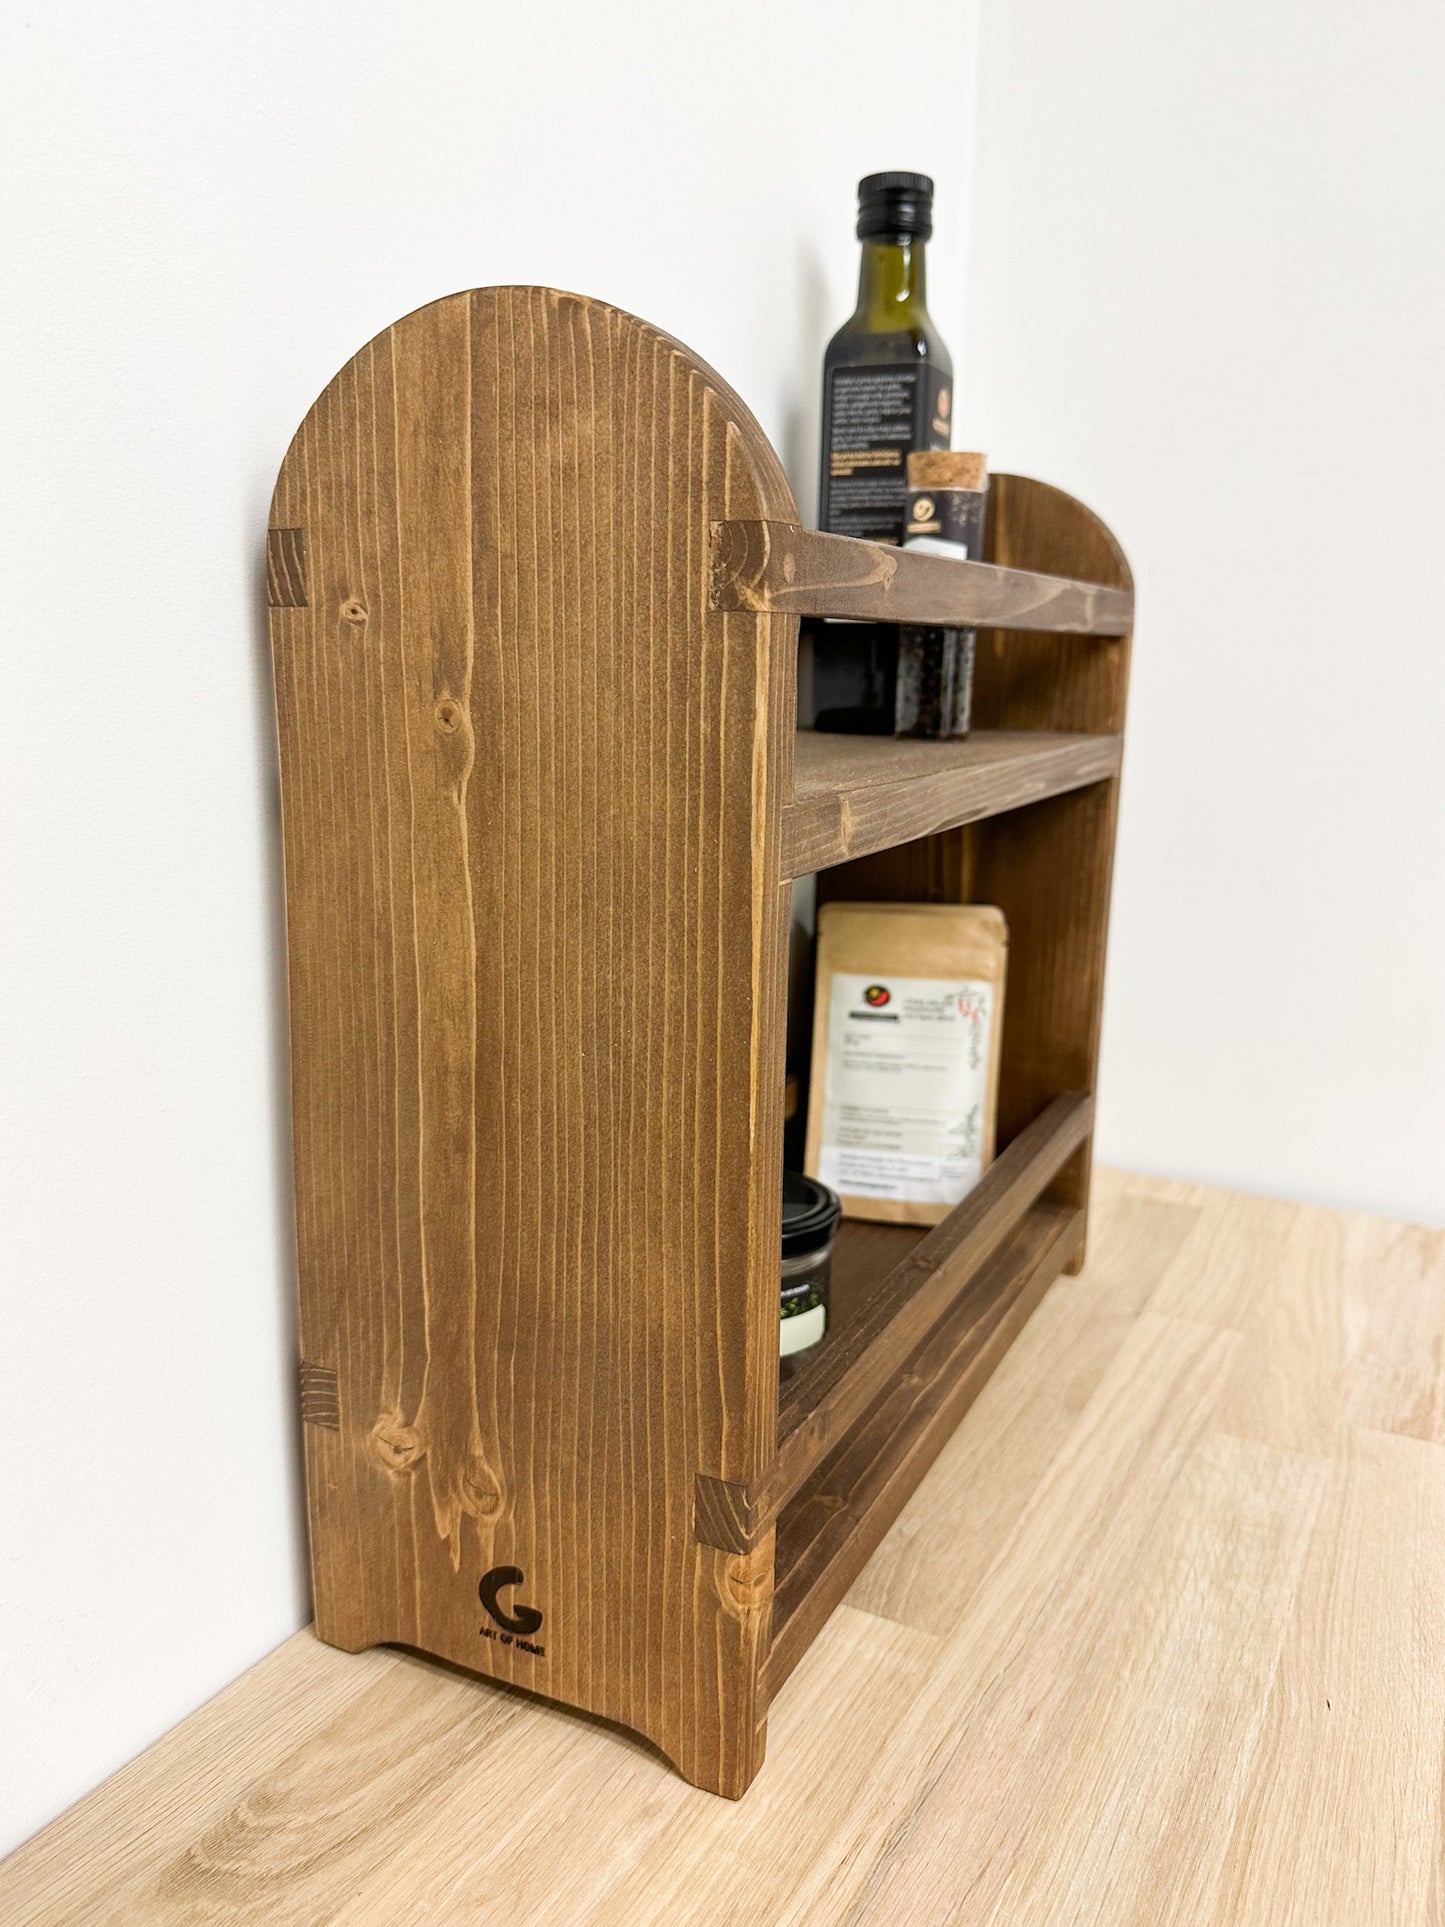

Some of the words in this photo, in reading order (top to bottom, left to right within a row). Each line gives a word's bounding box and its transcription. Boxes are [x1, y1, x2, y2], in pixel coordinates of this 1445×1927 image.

[479, 1627, 497, 1641] ART
[500, 1633, 513, 1645] OF
[516, 1638, 546, 1657] HOME
